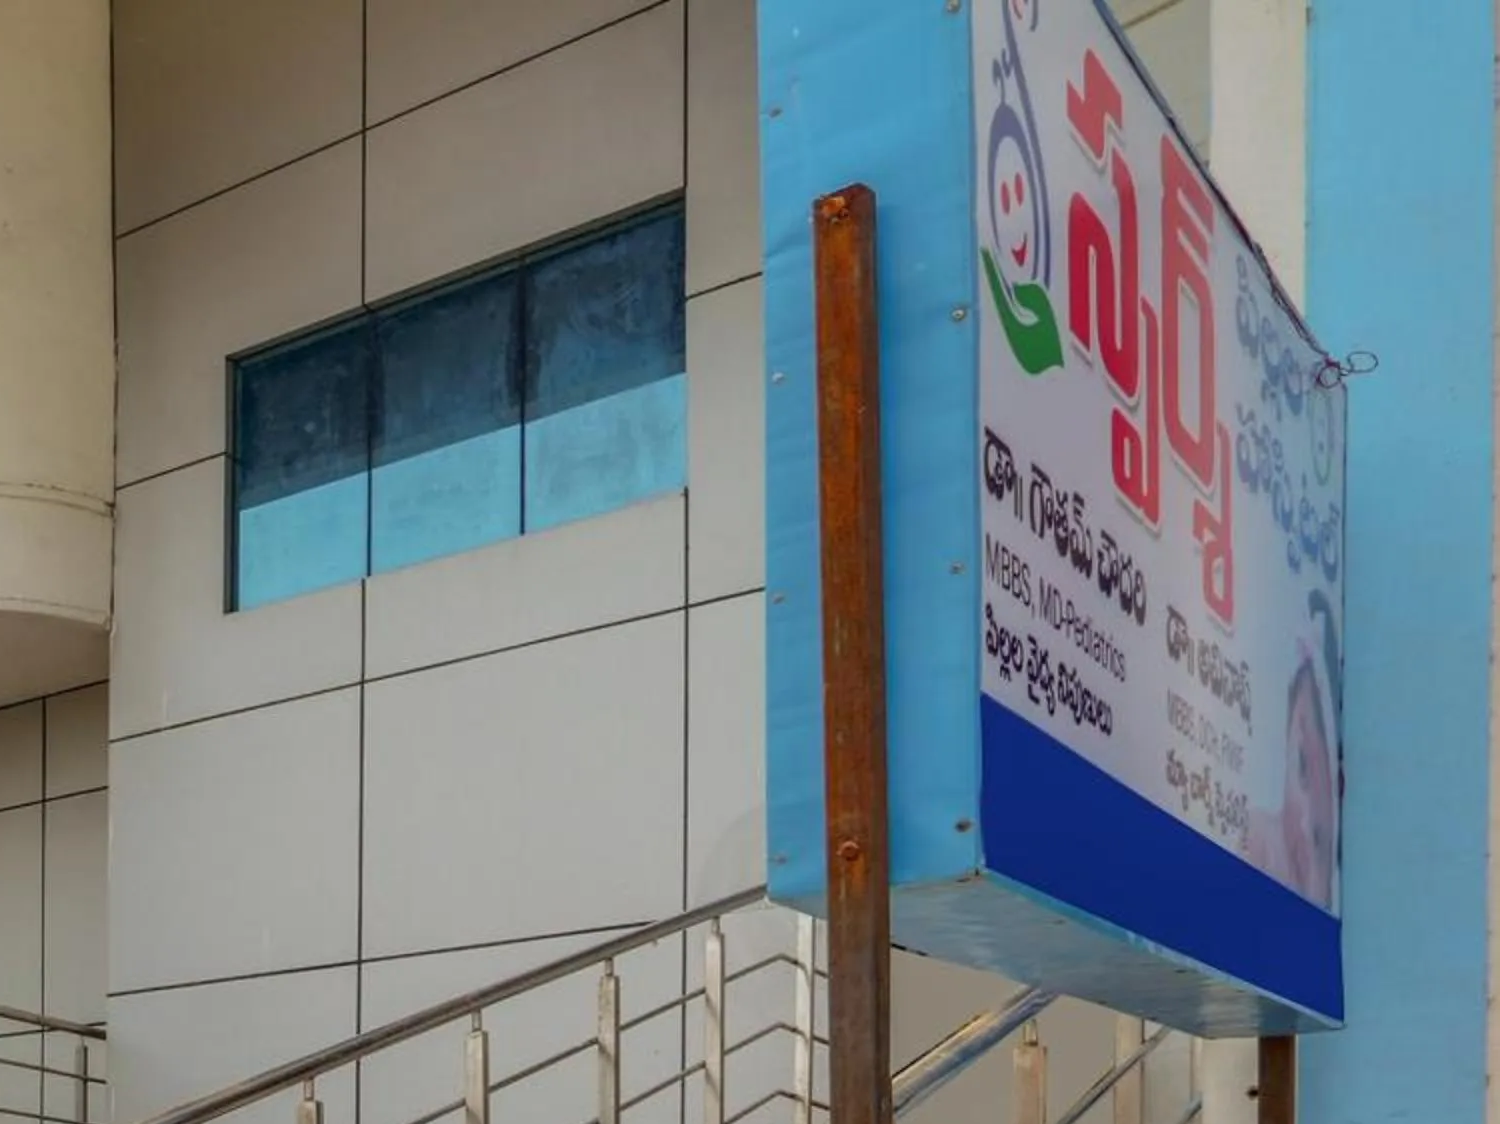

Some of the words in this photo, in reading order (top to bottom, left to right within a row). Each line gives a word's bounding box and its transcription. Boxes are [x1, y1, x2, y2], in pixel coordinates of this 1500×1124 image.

[986, 532, 1035, 619] MBBS,
[1039, 576, 1126, 683] MD-Pediatrics
[1030, 462, 1092, 579] గౌతమ్
[1097, 529, 1147, 626] చౌదరి
[986, 602, 1024, 682] పిల్లల
